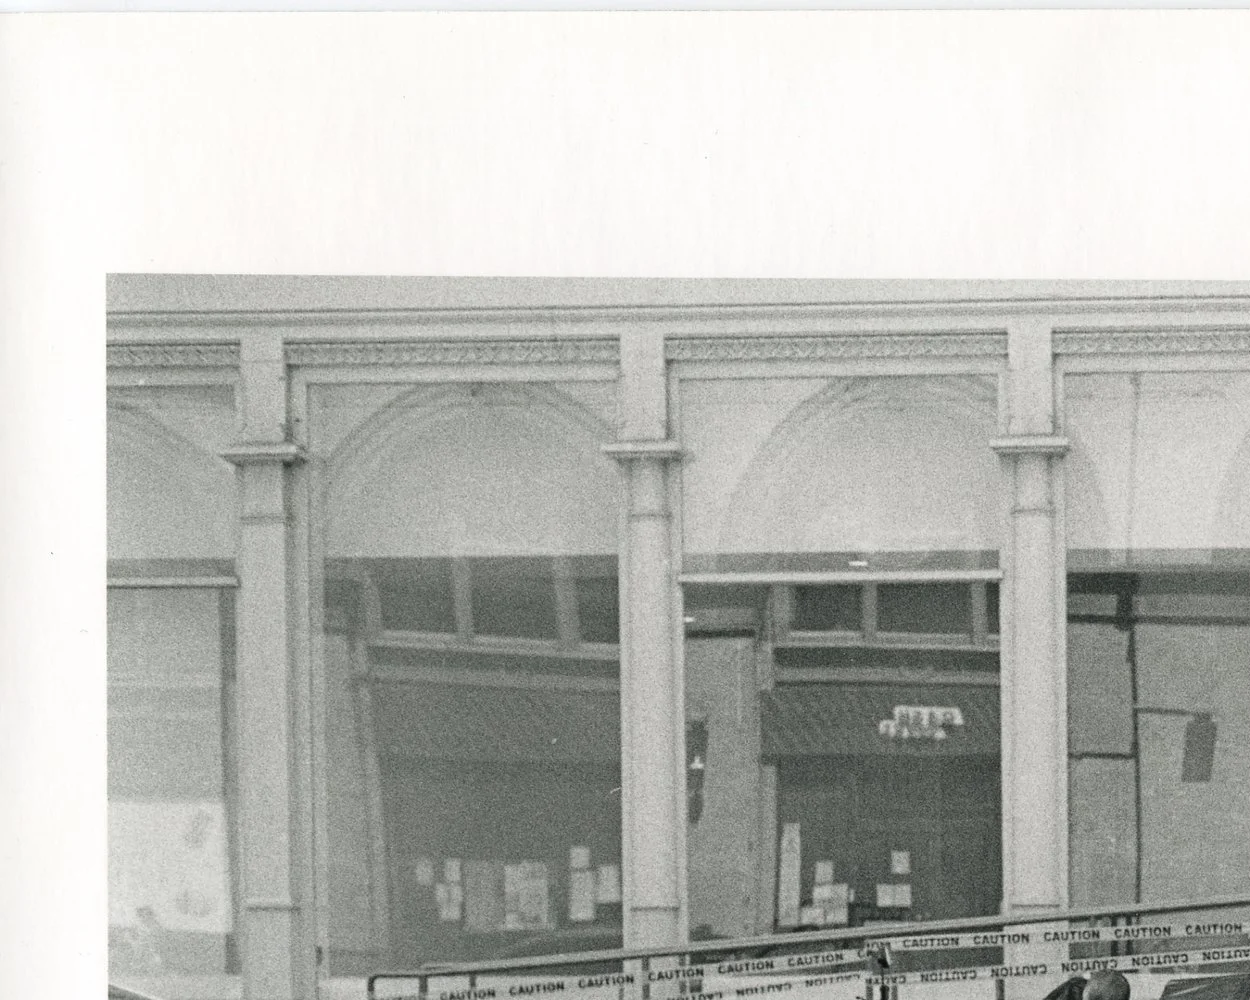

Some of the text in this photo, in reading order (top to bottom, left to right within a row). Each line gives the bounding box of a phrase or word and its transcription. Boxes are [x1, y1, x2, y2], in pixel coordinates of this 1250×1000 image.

[903, 936, 959, 949] CAUTION
[973, 932, 1030, 945] CAUTION
[1043, 930, 1100, 942] CAUTION
[1114, 926, 1171, 938] CAUTION
[1185, 922, 1243, 935] CAUTION
[1061, 959, 1118, 971] CAUTION
[1132, 953, 1189, 967] CAUTION
[509, 981, 566, 996] CAUTION
[578, 974, 635, 989] CAUTION
[648, 967, 705, 982] CAUTION
[718, 960, 775, 974] CAUTION
[787, 952, 844, 967] CAUTION
[921, 969, 978, 982] CAUTION
[991, 964, 1048, 977] CAUTION
